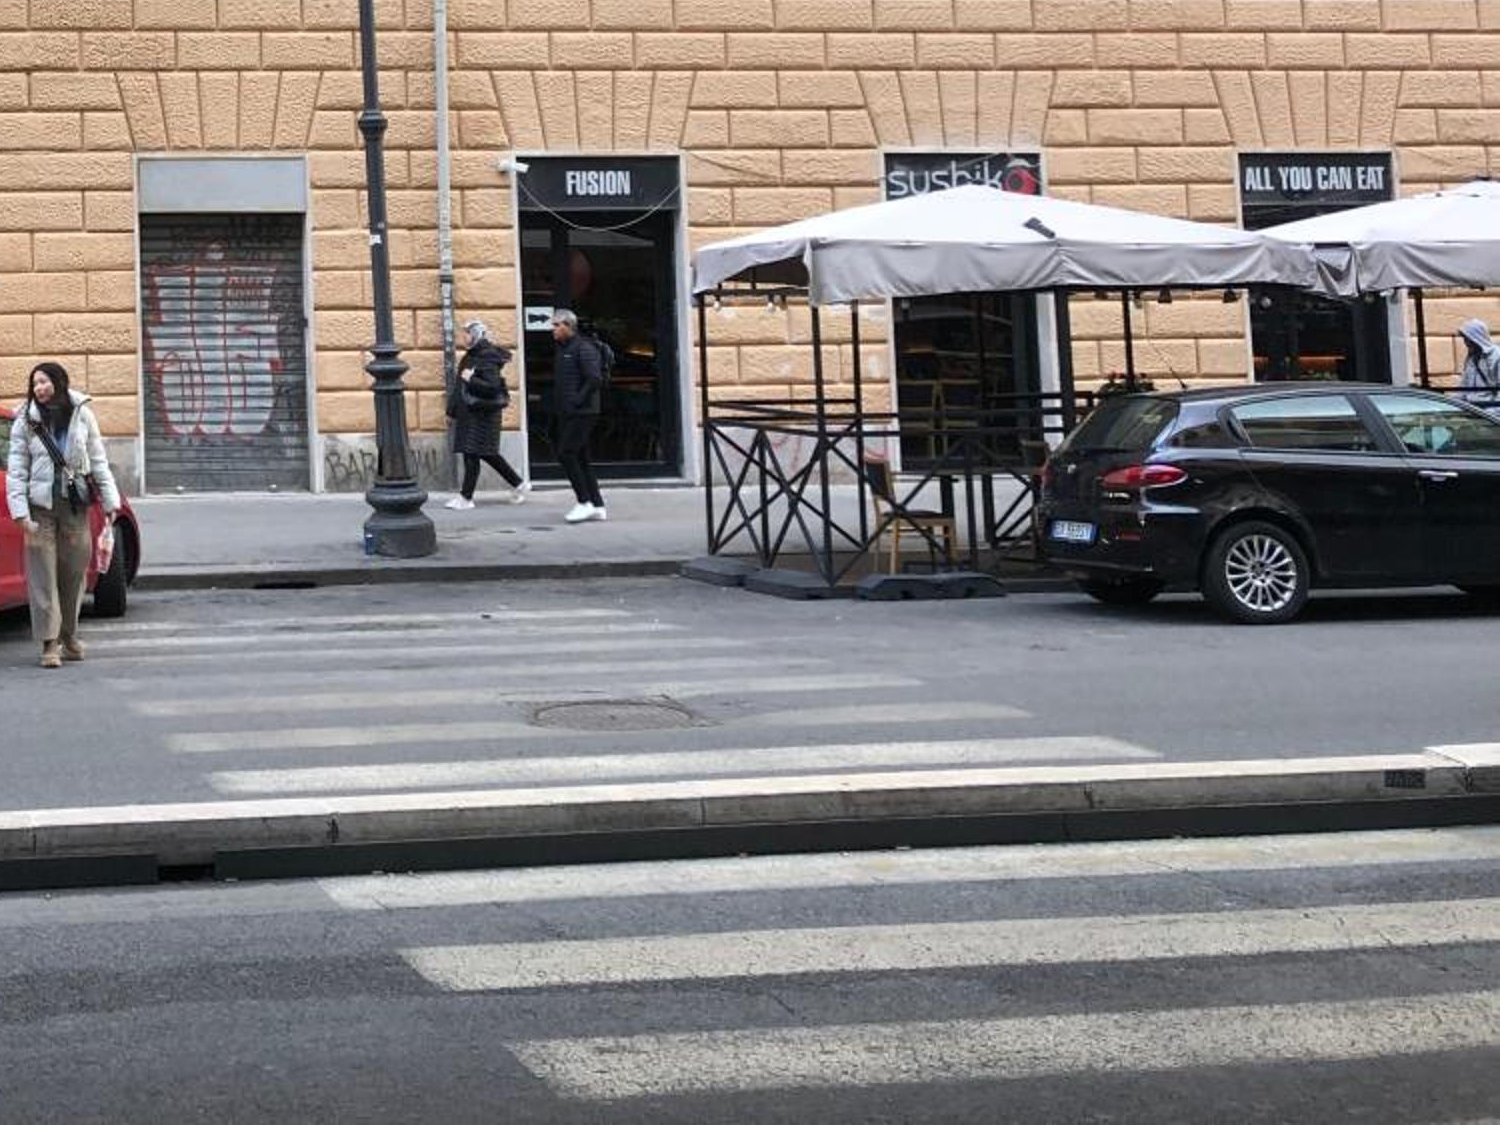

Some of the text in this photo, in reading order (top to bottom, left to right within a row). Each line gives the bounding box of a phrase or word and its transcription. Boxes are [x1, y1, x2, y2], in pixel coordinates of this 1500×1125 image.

[565, 170, 632, 196] FUSION
[1245, 166, 1385, 191] ALL YOU CAN EAT
